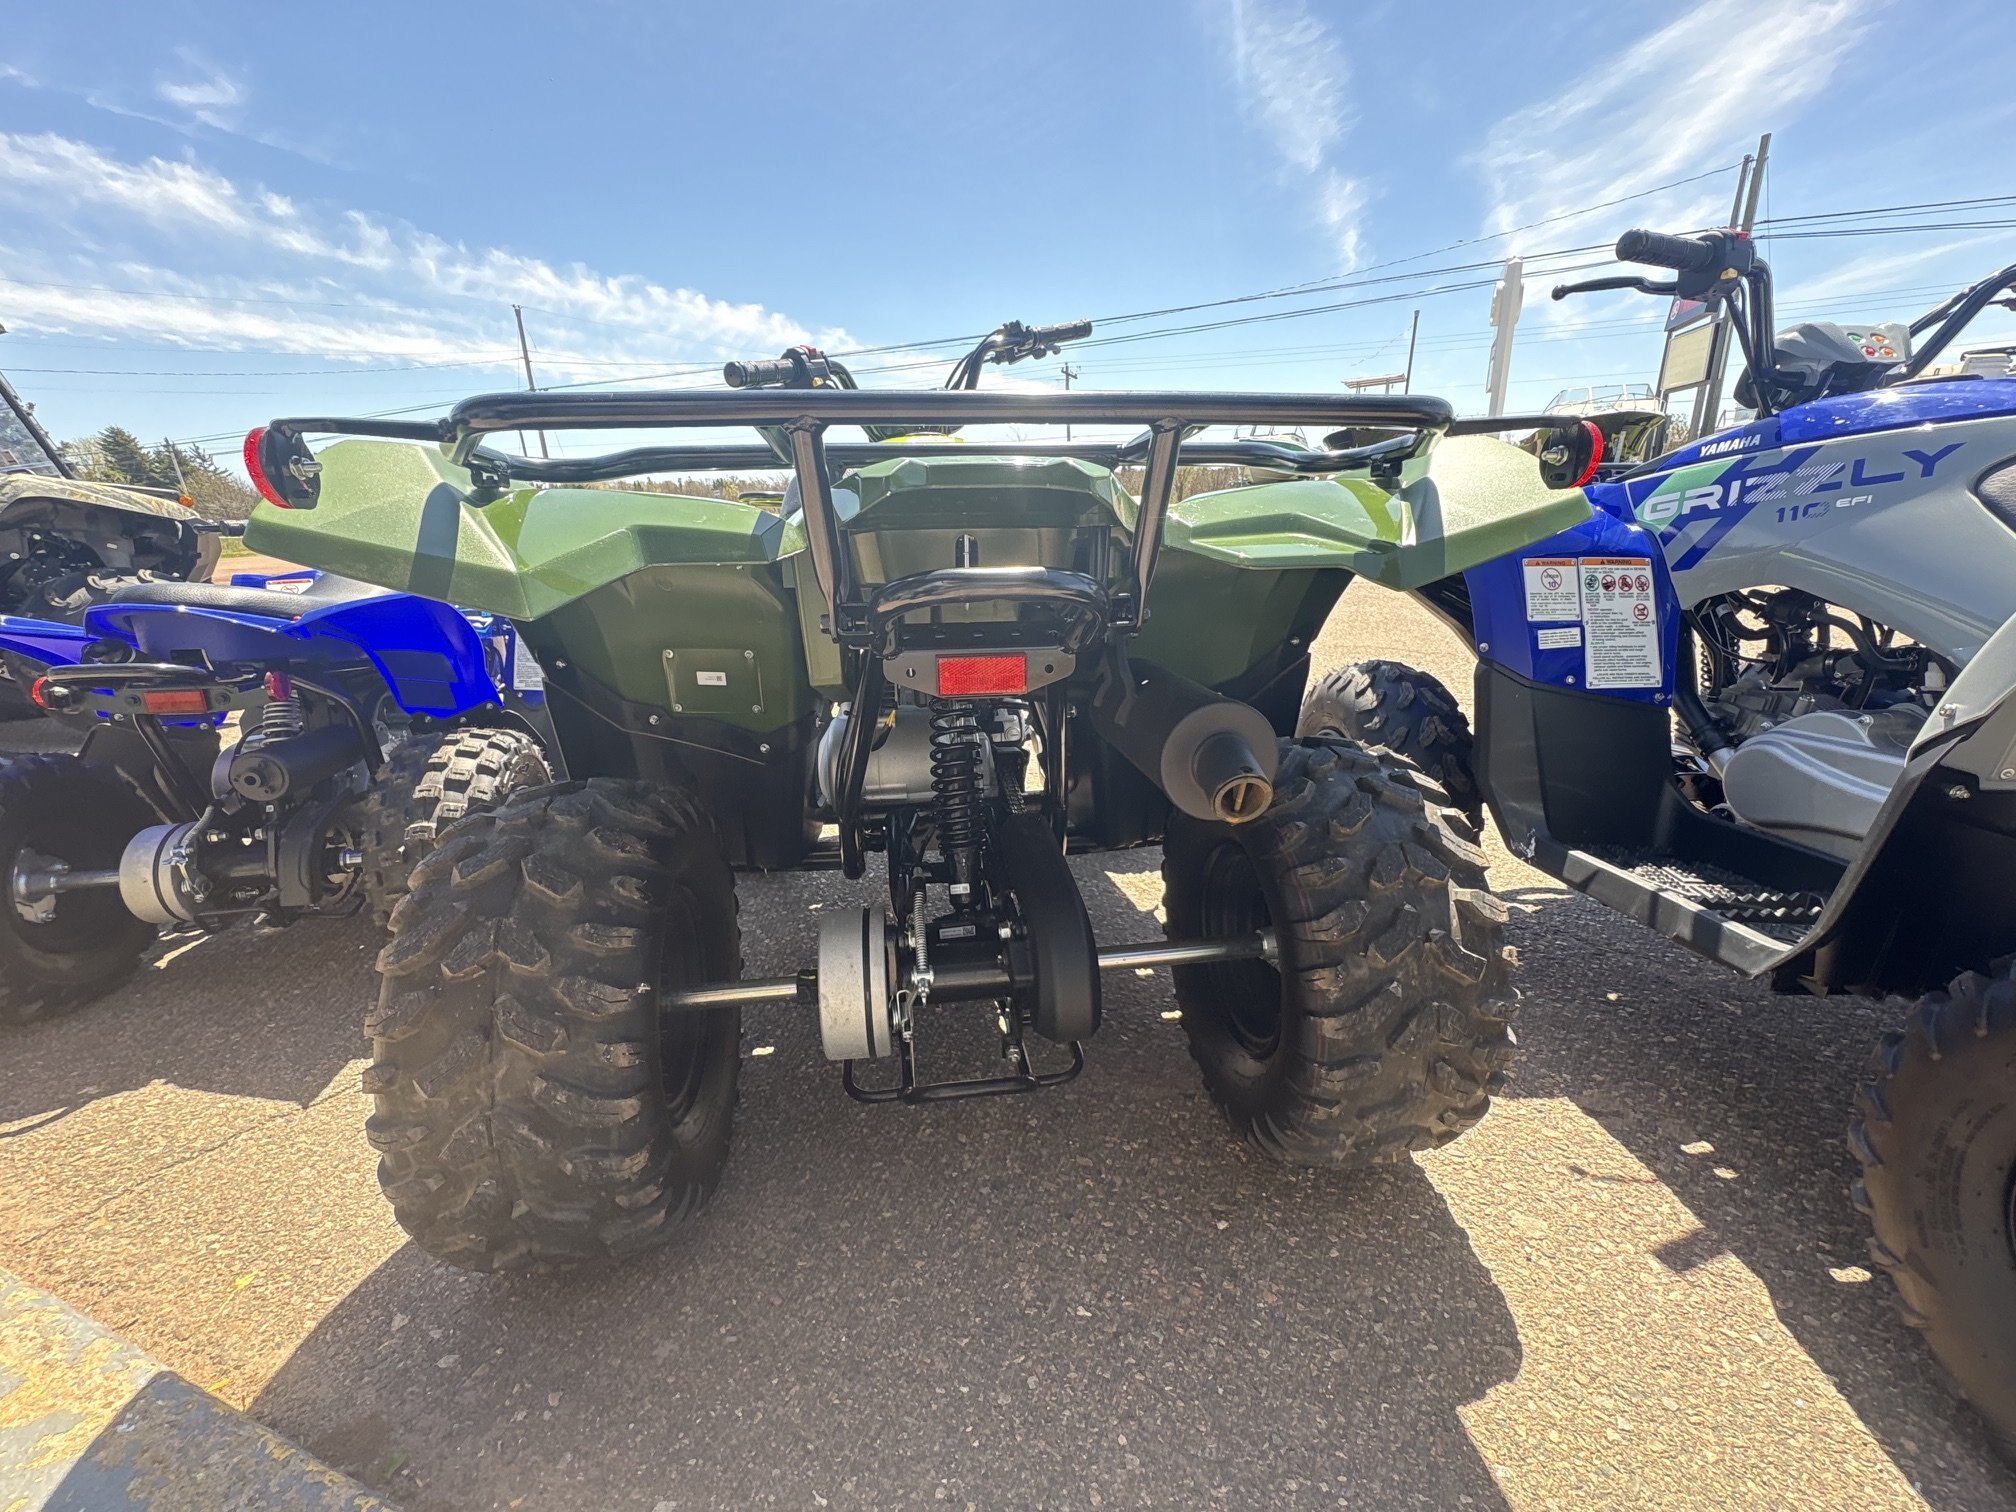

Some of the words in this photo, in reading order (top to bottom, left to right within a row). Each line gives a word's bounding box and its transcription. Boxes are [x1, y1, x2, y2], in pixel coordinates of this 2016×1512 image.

[1699, 434, 1761, 457] YAMAHA
[1642, 442, 1967, 521] GRIZZLY
[1776, 501, 1830, 523] 110
[1836, 495, 1872, 508] EFI
